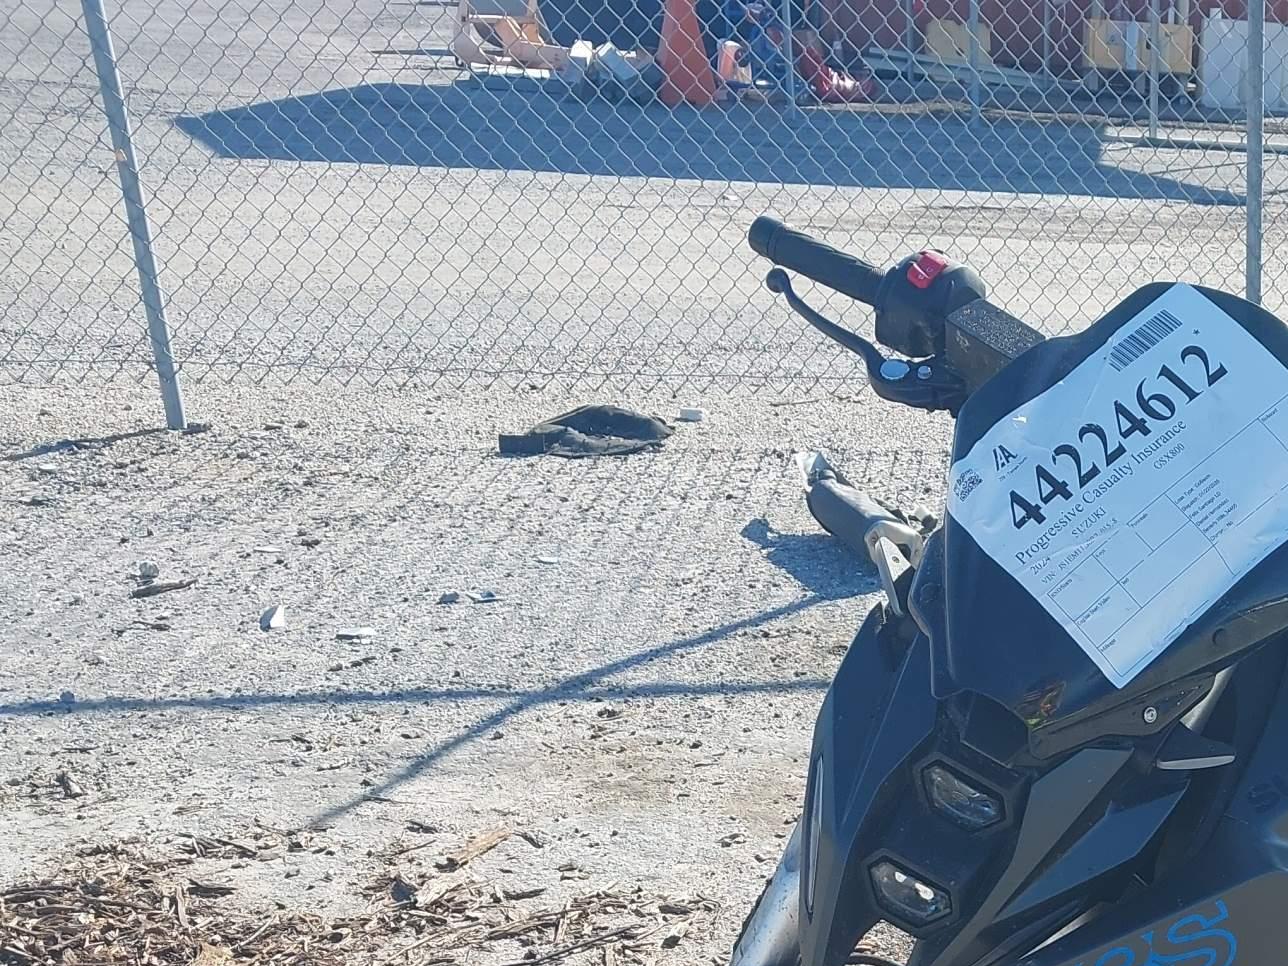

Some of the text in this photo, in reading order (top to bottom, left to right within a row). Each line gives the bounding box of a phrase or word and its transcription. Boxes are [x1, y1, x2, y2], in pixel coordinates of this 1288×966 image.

[1009, 345, 1228, 529] 44224612
[1015, 421, 1186, 565] Progressive Casualty Insurance
[1072, 507, 1106, 538] SUZUKI
[1154, 443, 1184, 469] GSX800
